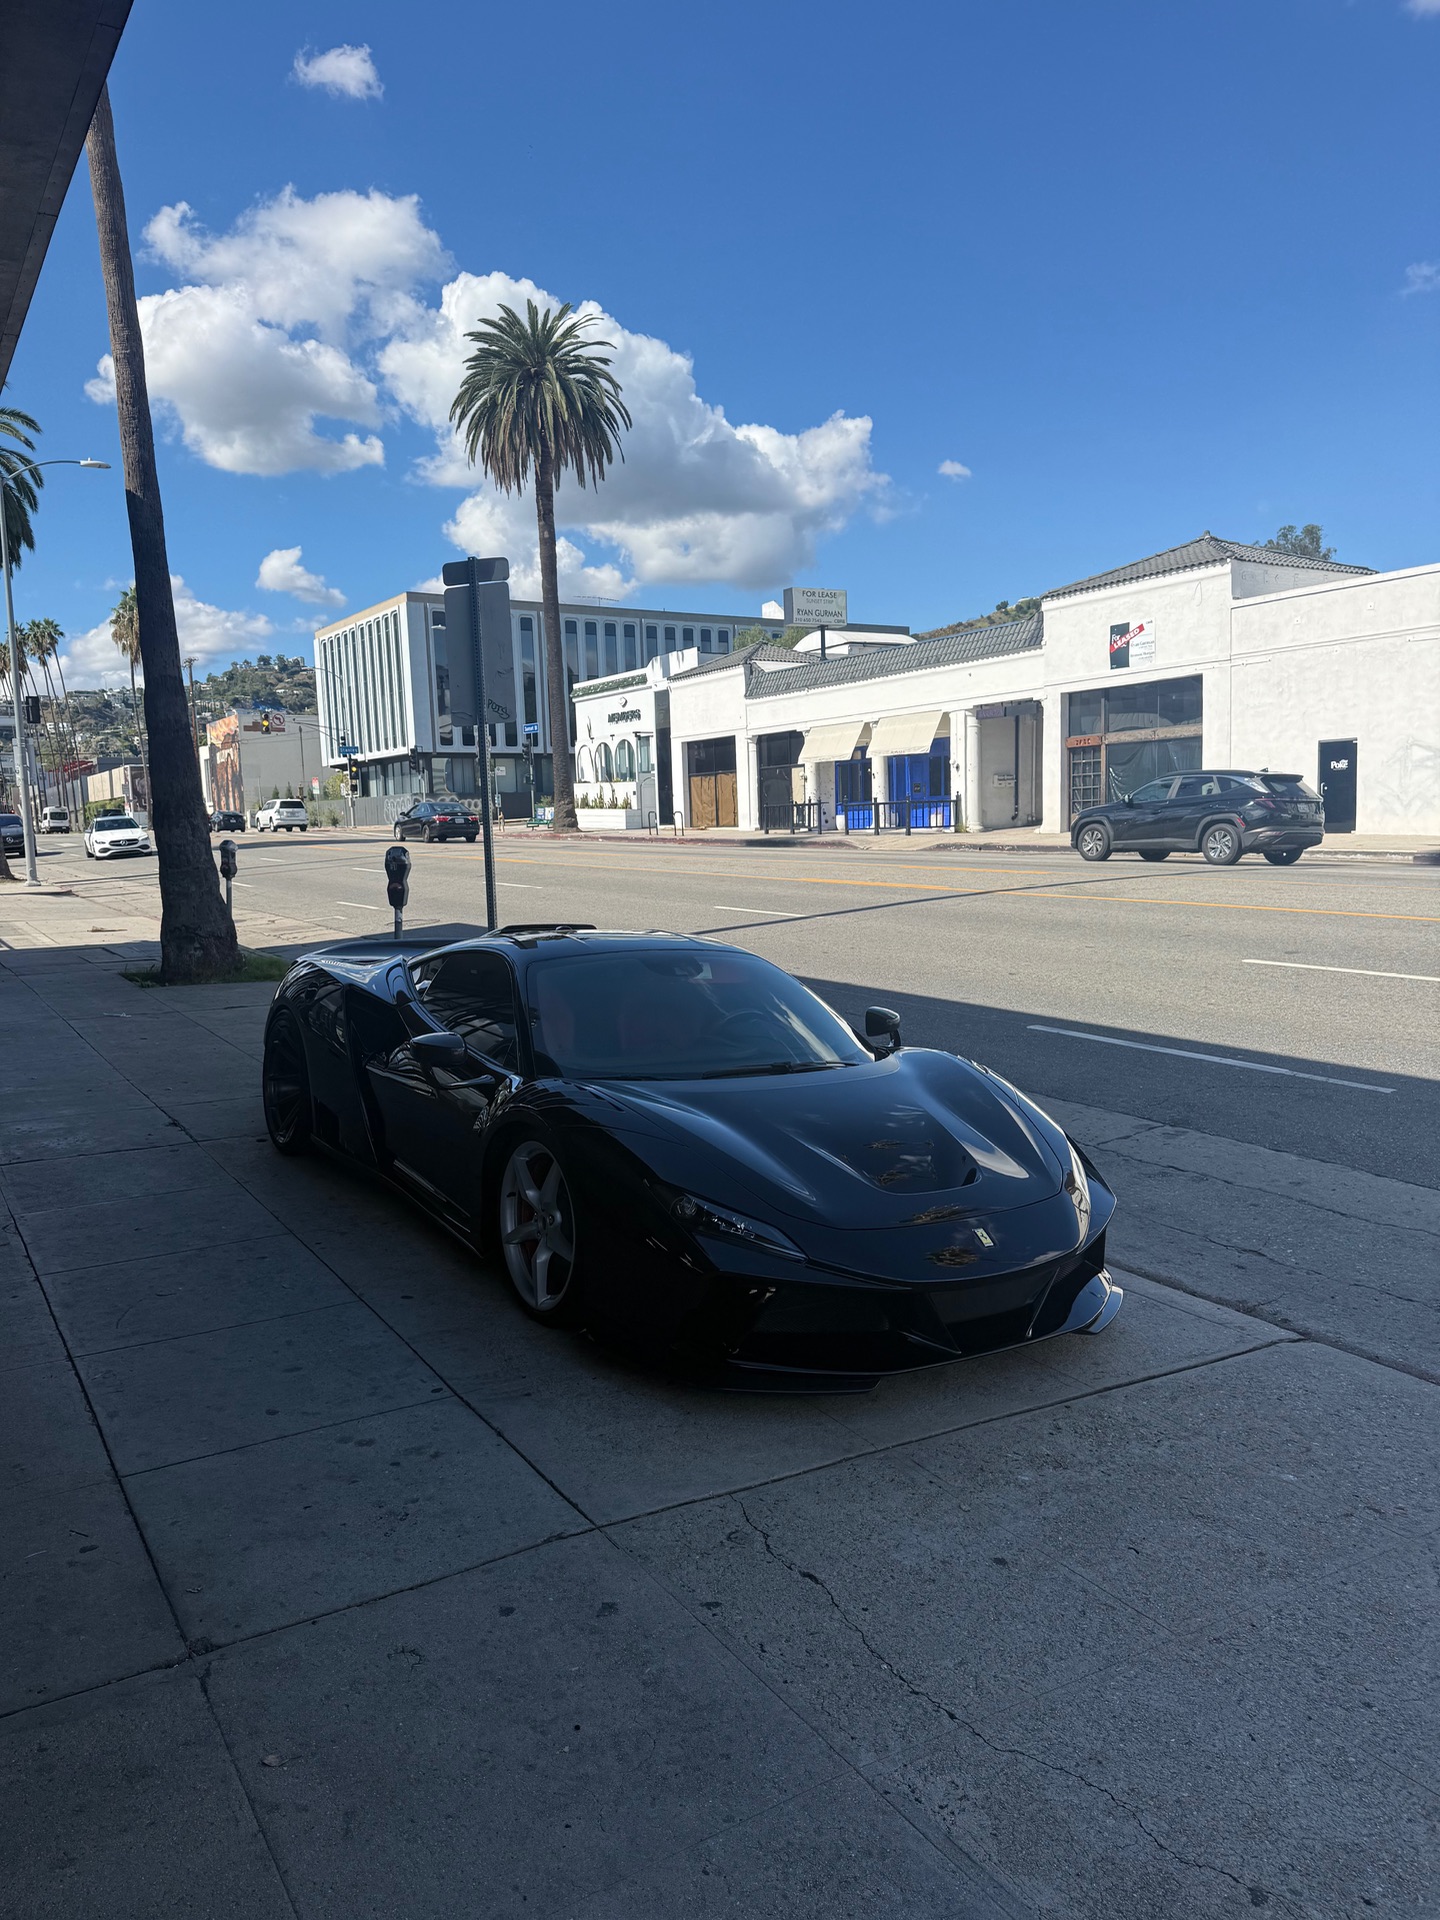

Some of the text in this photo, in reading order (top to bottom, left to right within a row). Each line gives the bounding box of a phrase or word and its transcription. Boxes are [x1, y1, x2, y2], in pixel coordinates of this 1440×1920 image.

[802, 590, 838, 599] FOR LEASE
[796, 608, 843, 618] RYAN GURMAN
[1113, 628, 1140, 649] LEASED
